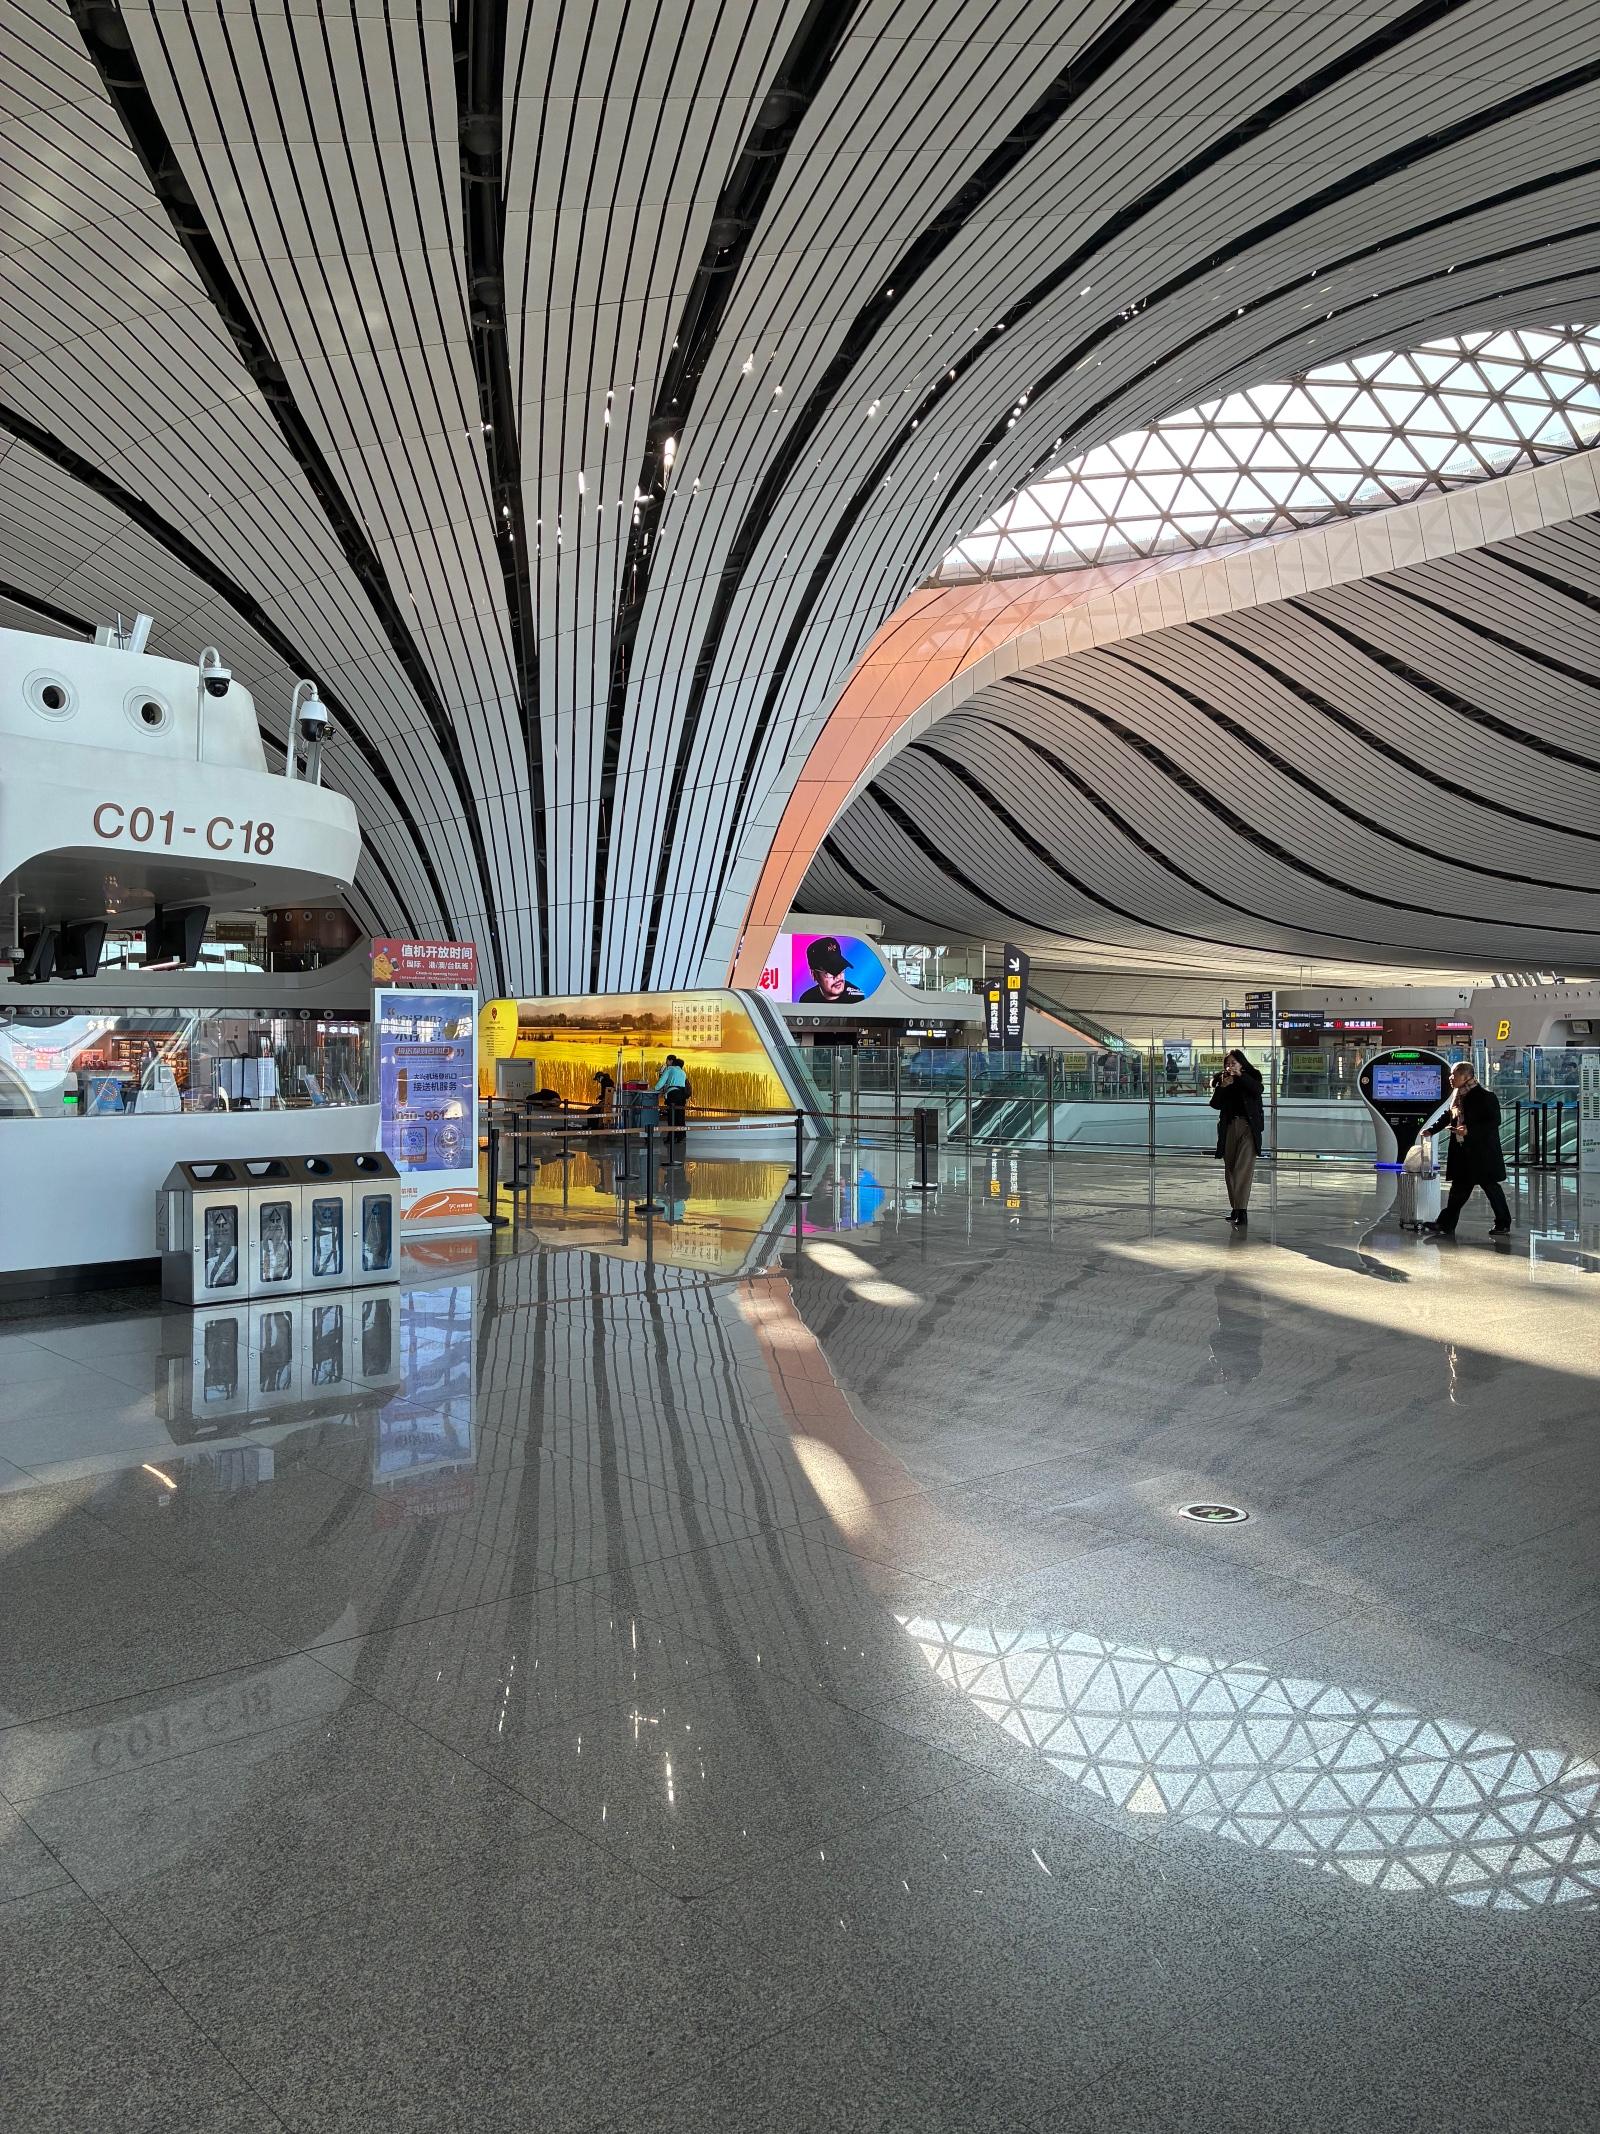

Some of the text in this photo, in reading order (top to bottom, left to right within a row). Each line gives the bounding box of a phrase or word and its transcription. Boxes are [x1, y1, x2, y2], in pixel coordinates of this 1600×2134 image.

[94, 802, 275, 856] C01-C18
[401, 944, 473, 960] 值机开放时间
[1496, 1020, 1511, 1040] B
[413, 1081, 457, 1092] 接送机服务
